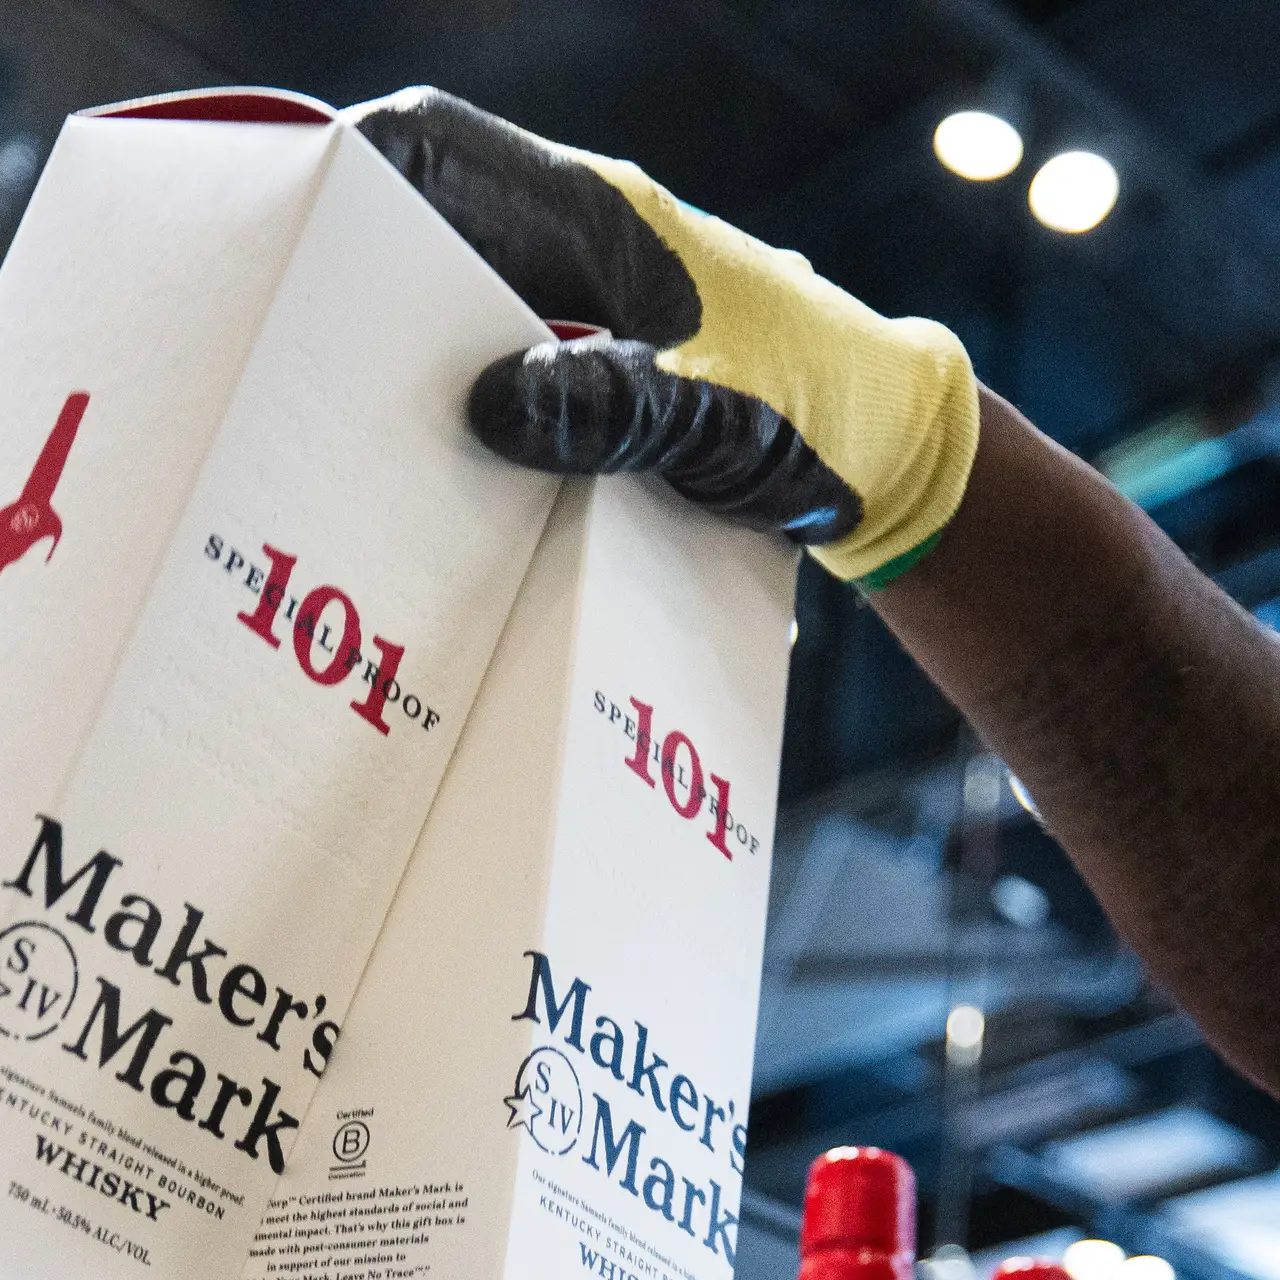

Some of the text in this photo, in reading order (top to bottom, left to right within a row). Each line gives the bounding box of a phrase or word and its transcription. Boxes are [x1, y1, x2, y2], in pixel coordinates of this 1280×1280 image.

[204, 532, 440, 732] SPECIAL PROOF
[237, 542, 405, 736] 101
[594, 689, 760, 856] SPECIAL PROOF
[624, 694, 733, 862] 101
[1, 812, 344, 1079] Maker's
[61, 976, 300, 1176] Mark
[511, 950, 749, 1177] Maker's
[336, 1107, 374, 1120] Certified
[8, 1181, 30, 1202] 750
[56, 1205, 91, 1234] 50.5%
[36, 1134, 170, 1221] WHISKY
[78, 1131, 154, 1179] STRAIGHT
[157, 1174, 225, 1220] BOURBON
[176, 1162, 186, 1174] in
[265, 1196, 468, 1224] meet the highest standards of social and
[298, 1191, 343, 1205] Certified
[345, 1188, 376, 1200] brand
[378, 1185, 420, 1197] Maker's
[422, 1182, 451, 1194] Mark
[454, 1182, 463, 1192] is
[581, 1091, 739, 1270] Mark
[248, 1232, 429, 1257] made with post-consumer materials
[266, 1252, 406, 1272] in support of our mission to
[335, 1222, 365, 1234] That's
[367, 1220, 388, 1232] why
[390, 1218, 410, 1229] this
[411, 1216, 431, 1230] gift
[434, 1215, 453, 1225] box
[455, 1214, 465, 1224] is
[539, 1194, 601, 1240] KENTUCKY
[605, 1236, 658, 1277] STRAIGHT
[367, 1269, 382, 1280] No
